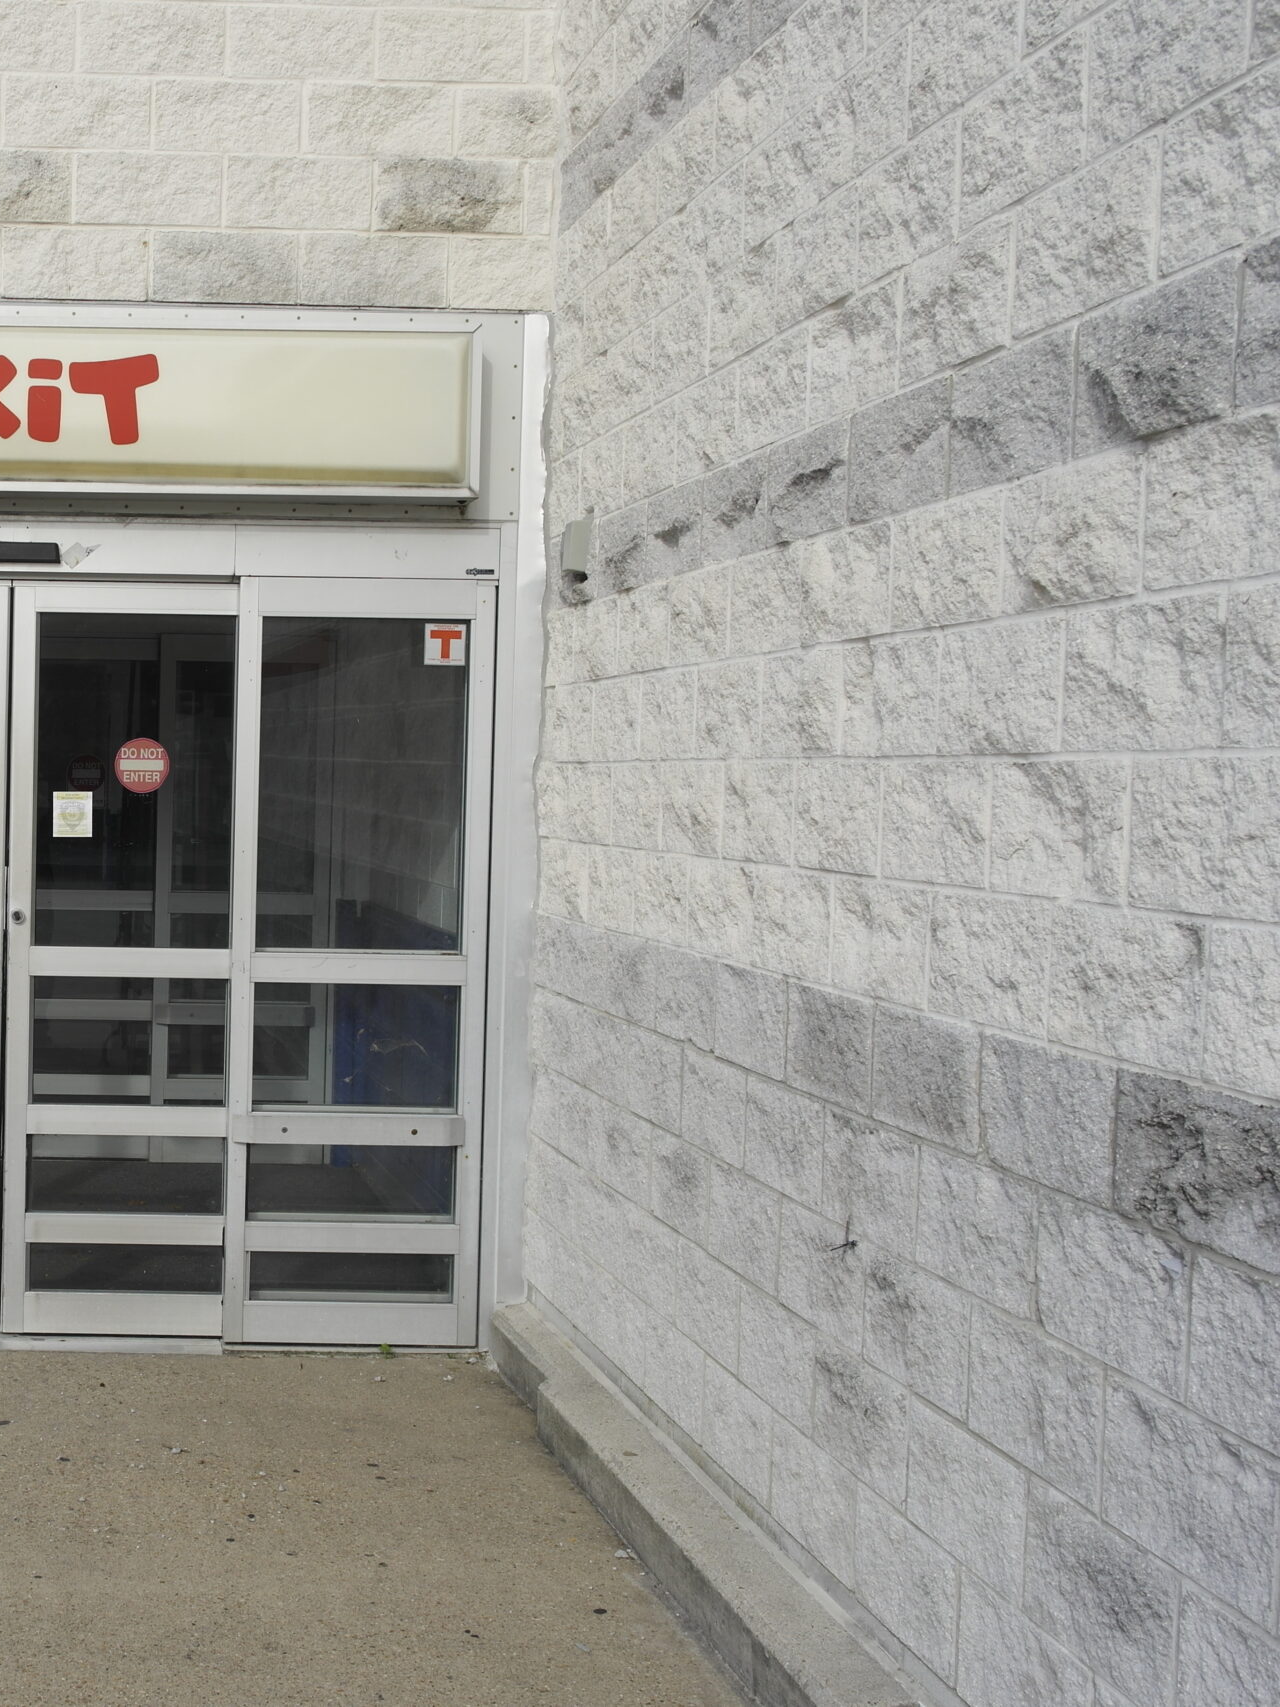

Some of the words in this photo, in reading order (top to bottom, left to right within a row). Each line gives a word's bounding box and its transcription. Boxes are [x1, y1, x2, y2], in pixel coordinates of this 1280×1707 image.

[430, 630, 462, 658] T
[121, 748, 138, 759] DO
[140, 748, 164, 759] NOT
[123, 771, 160, 783] ENTER
